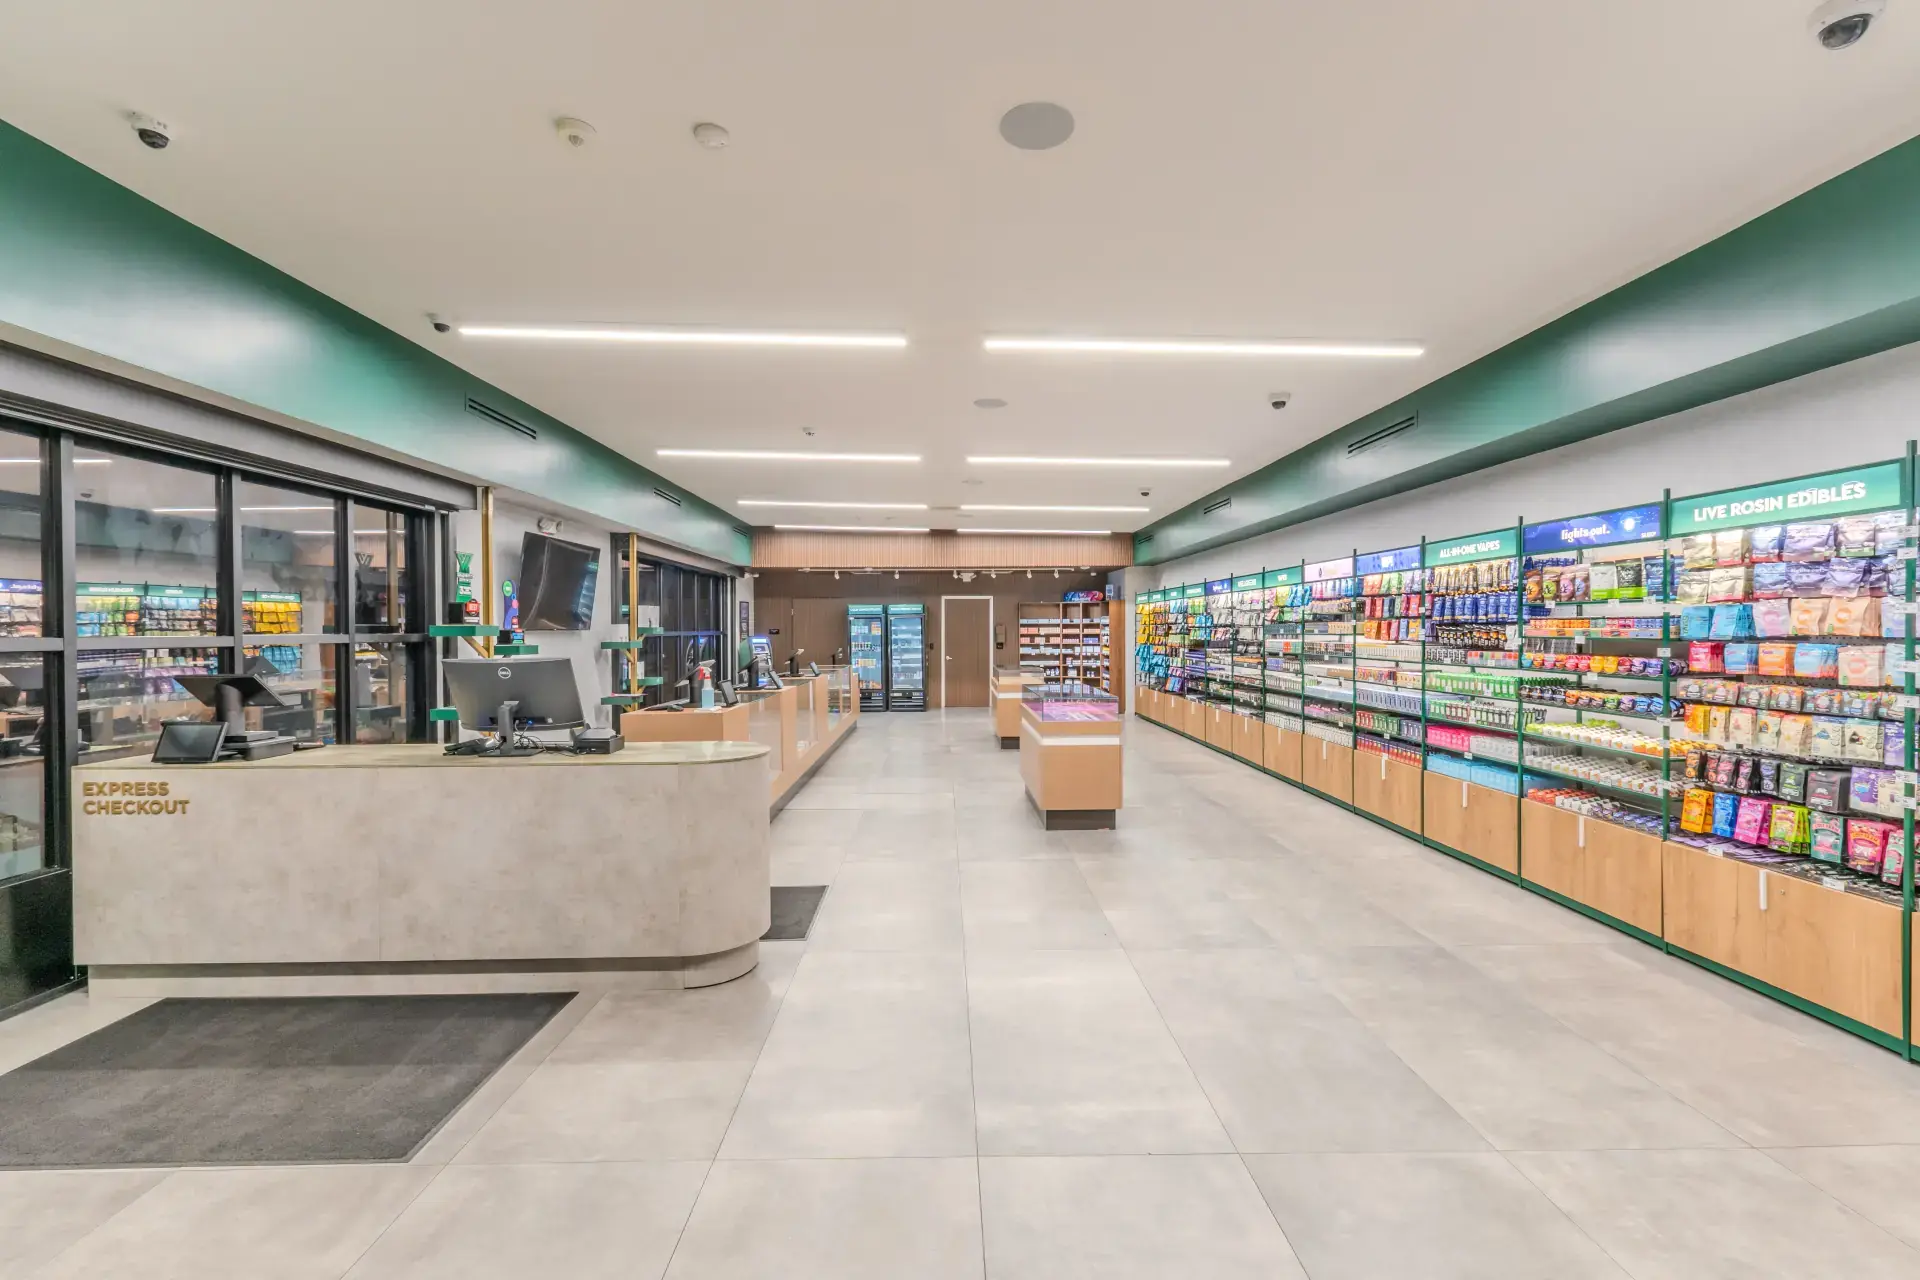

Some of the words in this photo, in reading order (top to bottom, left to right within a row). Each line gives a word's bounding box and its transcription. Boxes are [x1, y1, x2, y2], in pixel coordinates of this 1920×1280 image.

[1694, 504, 1727, 522] LIVE
[1730, 496, 1784, 517] ROSIN
[1787, 483, 1866, 508] EDIBLES
[1439, 544, 1477, 558] ALL-IN-ONE
[1477, 540, 1500, 553] VAPES
[82, 781, 170, 797] EXPRESS
[82, 799, 190, 815] CHECKOUT
